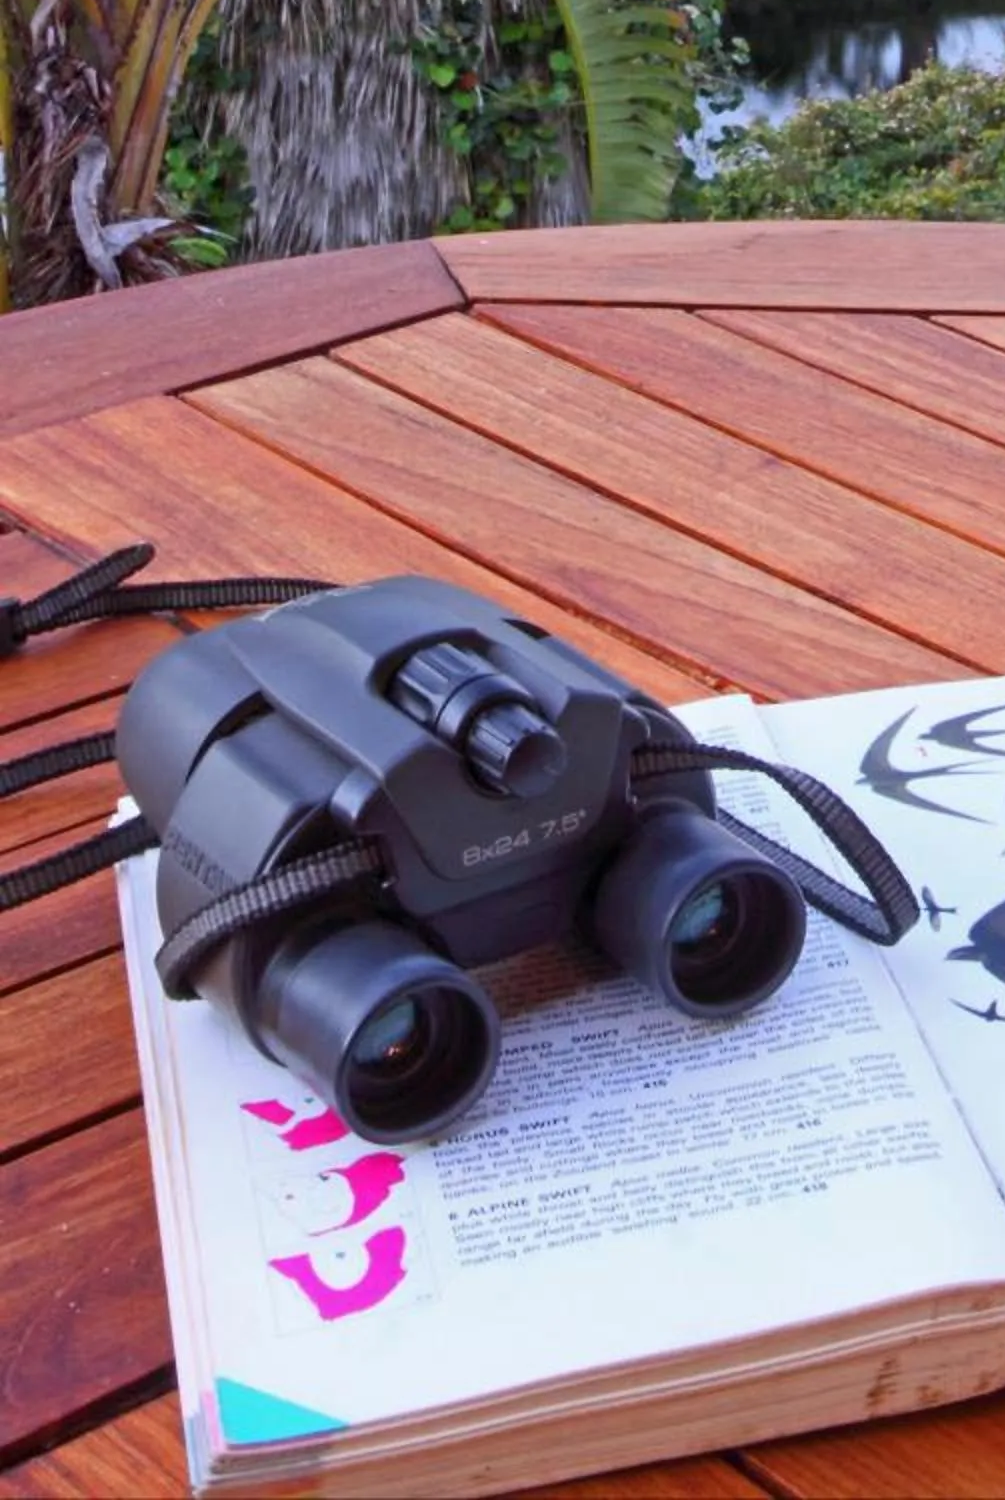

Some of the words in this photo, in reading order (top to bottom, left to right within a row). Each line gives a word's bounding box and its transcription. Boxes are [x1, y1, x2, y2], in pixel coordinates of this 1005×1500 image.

[463, 828, 531, 867] 8x24
[570, 1028, 618, 1043] SWIFT
[446, 1127, 510, 1144] HORUS
[516, 1115, 570, 1131] SWIFT
[466, 1197, 528, 1216] ALPINE
[536, 1184, 590, 1201] SWIFT
